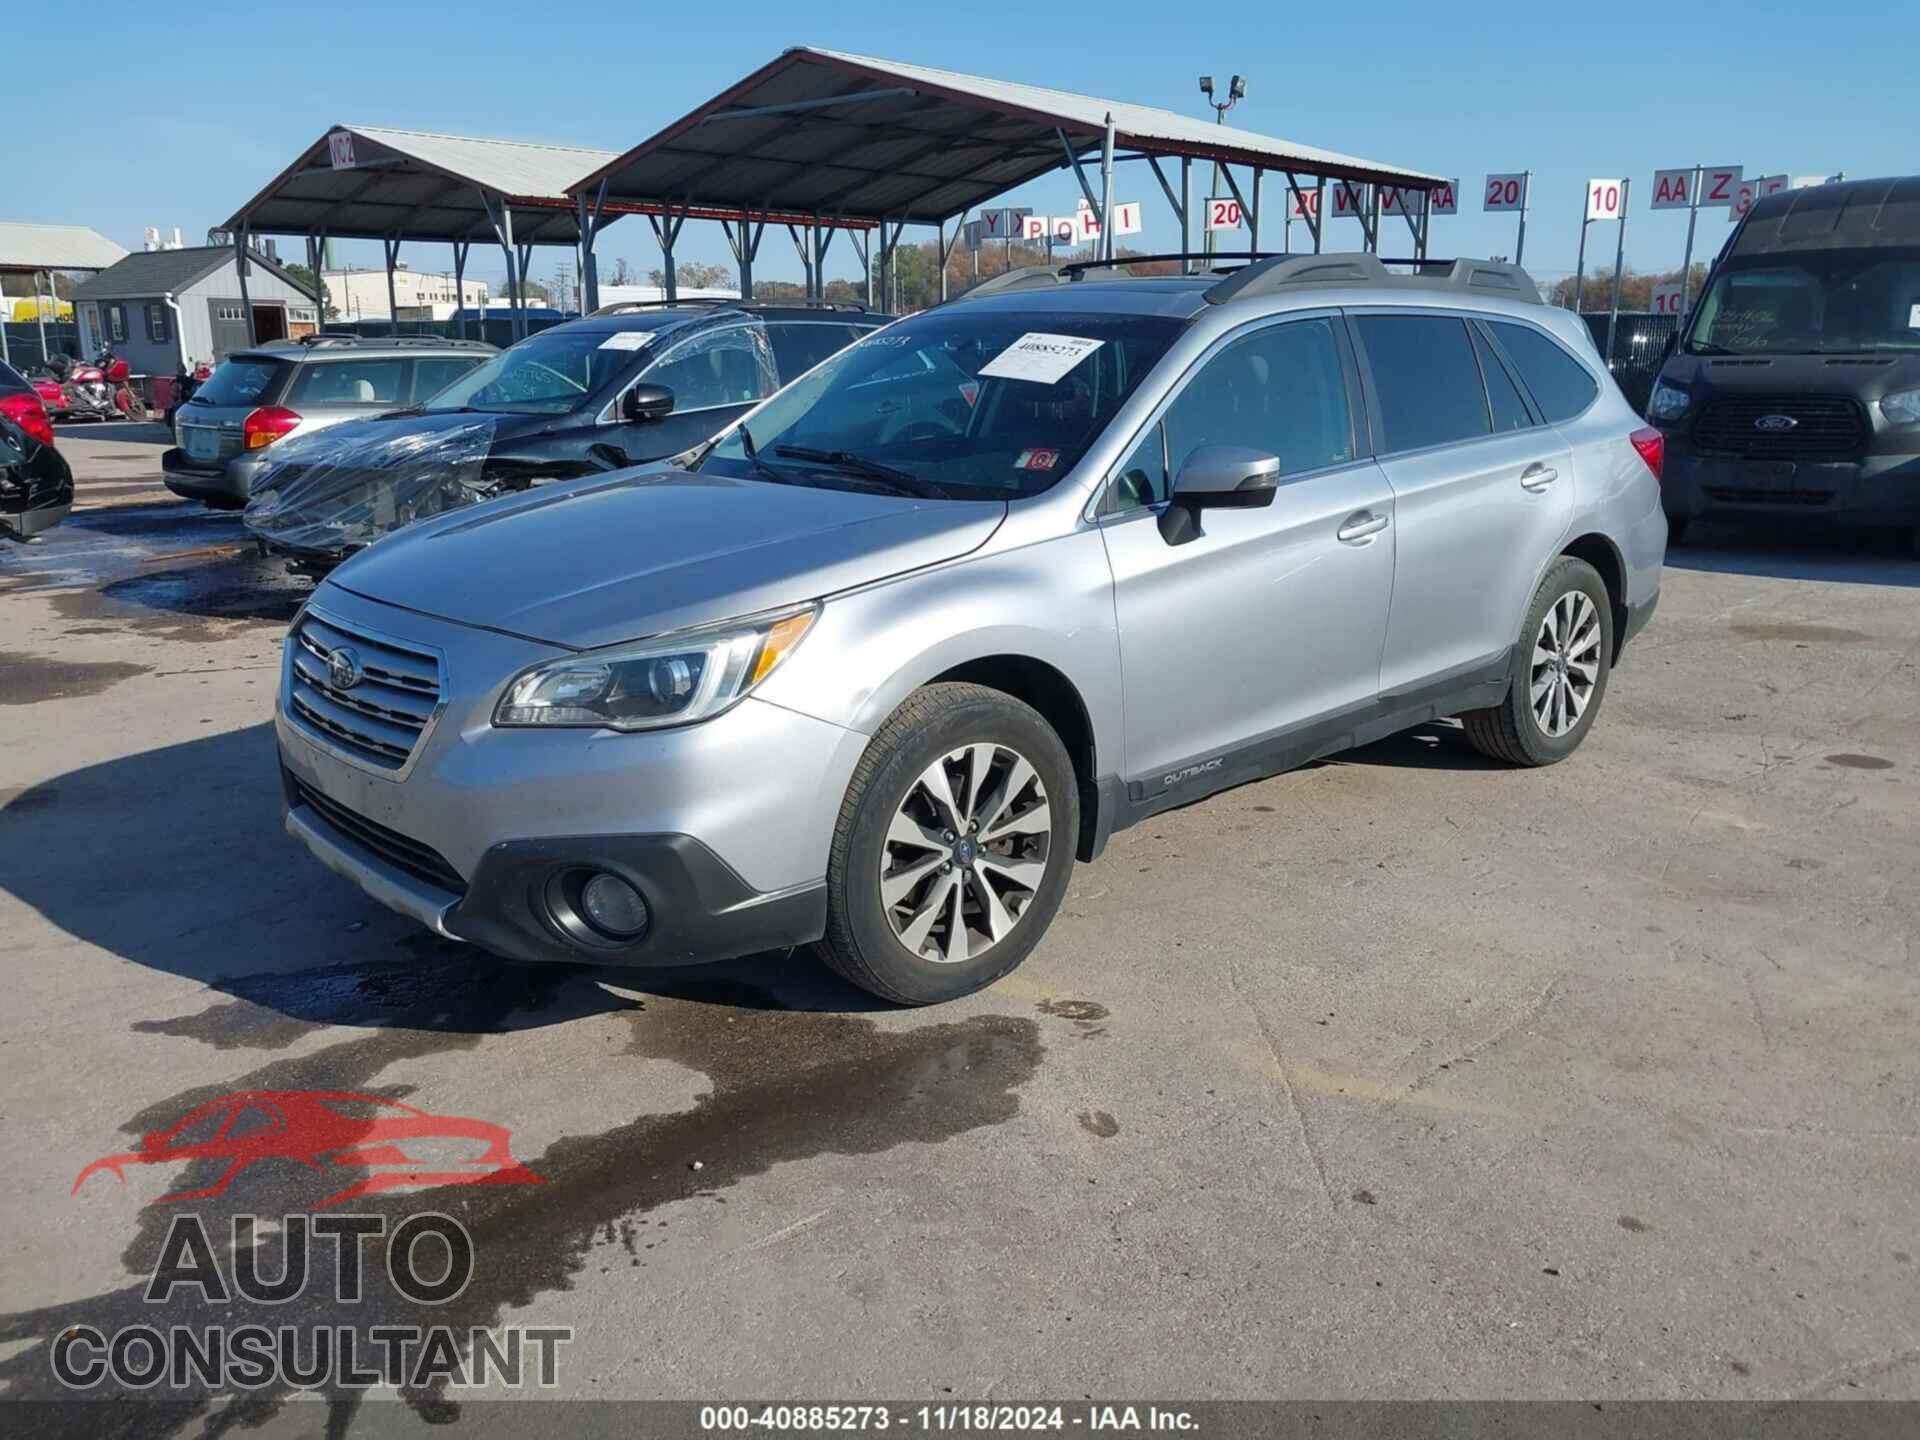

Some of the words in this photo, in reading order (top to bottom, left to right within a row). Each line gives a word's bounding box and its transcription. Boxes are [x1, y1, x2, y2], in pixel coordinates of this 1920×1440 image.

[1488, 181, 1519, 204] 20
[1656, 176, 1686, 202] AA
[1709, 174, 1733, 199] Z
[1593, 186, 1617, 211] 10
[986, 215, 998, 232] Y
[1084, 214, 1101, 234] H
[1213, 203, 1239, 224] 20
[1030, 221, 1042, 240] P
[1656, 293, 1681, 313] 10
[1164, 757, 1224, 785] OUTBACK
